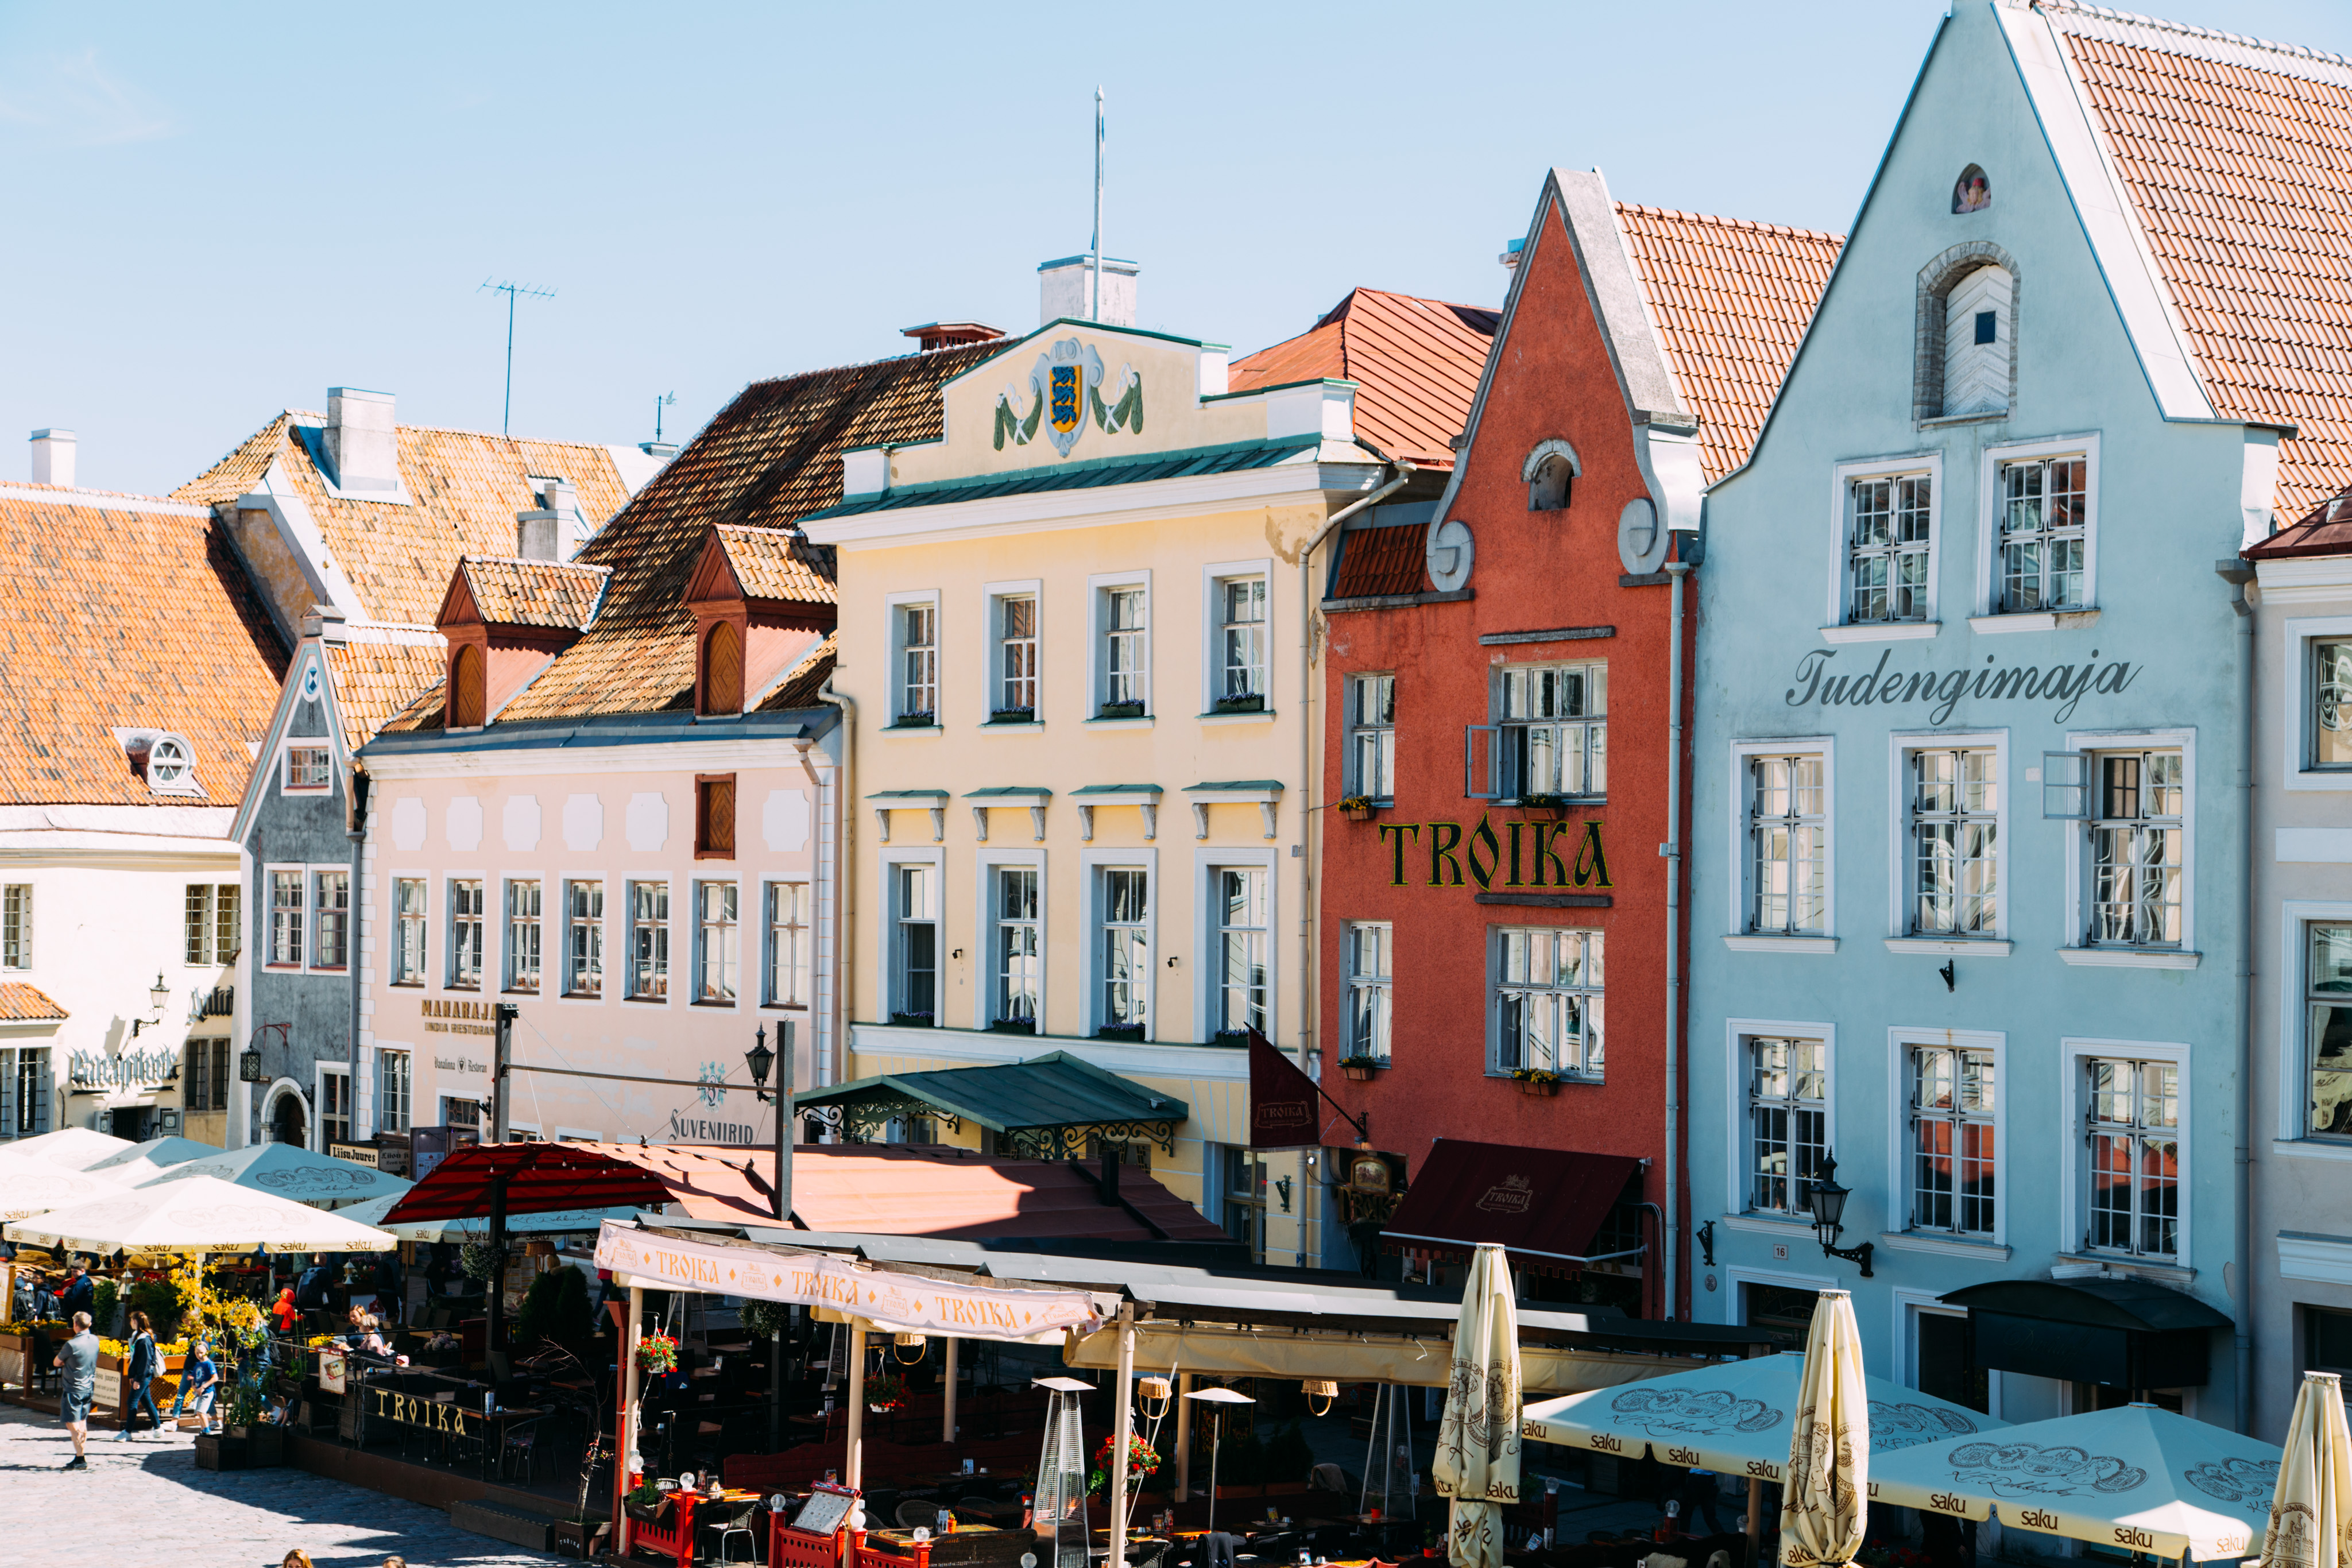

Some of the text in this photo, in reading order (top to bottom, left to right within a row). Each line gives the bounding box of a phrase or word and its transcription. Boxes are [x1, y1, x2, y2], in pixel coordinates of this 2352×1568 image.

[1785, 648, 2144, 726] Tudengimaja
[1378, 810, 1614, 892] TROIKA
[421, 999, 496, 1021] MAHARAJA
[424, 1022, 496, 1036] INDIA RESTORAN
[1261, 1106, 1303, 1118] TROIKA
[668, 1109, 753, 1144] SUVENIIRID
[1489, 1192, 1526, 1205] TROIKA
[5, 1209, 29, 1219] saku
[11, 1229, 24, 1240] saku
[38, 1233, 51, 1245] saku
[416, 1229, 430, 1240] saku
[68, 1236, 80, 1248] saku
[96, 1241, 110, 1252] saku
[143, 1242, 172, 1252] saku
[211, 1242, 239, 1252] saku
[279, 1240, 306, 1251] saku
[346, 1238, 372, 1250] saku
[616, 1251, 635, 1261] TROIKA
[1776, 1246, 1785, 1257] 16
[656, 1250, 720, 1284] TROIKA
[745, 1275, 765, 1284] TROIKA
[792, 1271, 859, 1306] TROIKA
[885, 1299, 906, 1311] TROIKA
[934, 1296, 1019, 1329] TROIKA
[375, 1389, 466, 1436] TROIKA
[1591, 1434, 1621, 1453] saku
[1669, 1446, 1700, 1465] saku
[1747, 1459, 1780, 1479] saku
[1931, 1492, 1966, 1514] saku
[2021, 1508, 2058, 1530] saku
[559, 1538, 580, 1549] TROIKA
[2114, 1527, 2153, 1549] saku
[2216, 1532, 2245, 1552] saku
